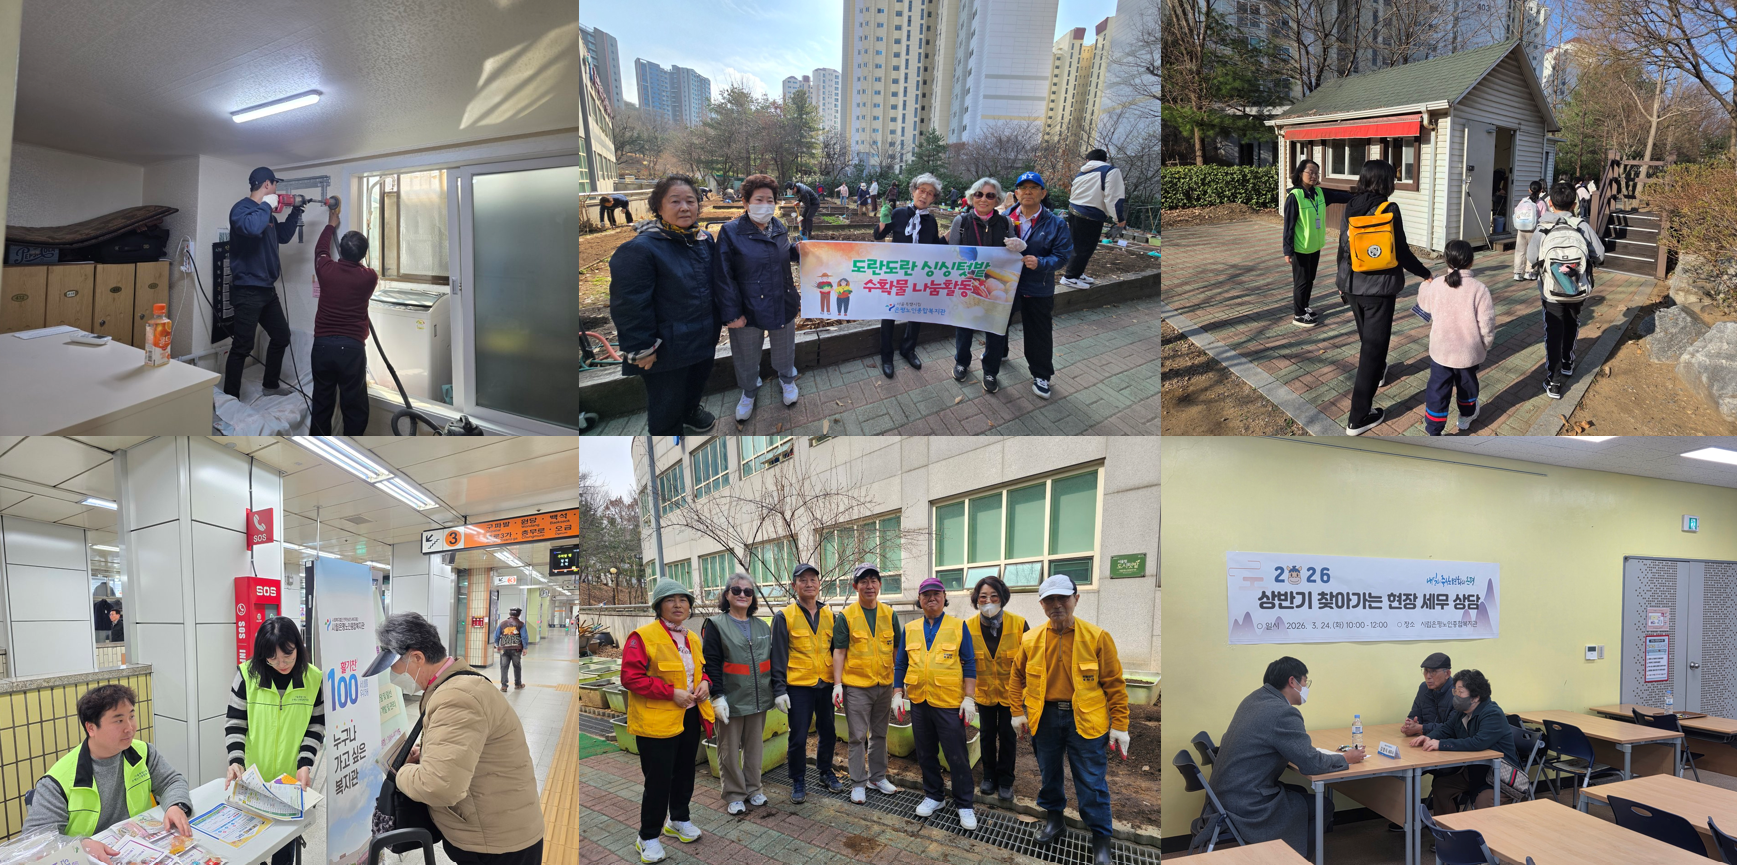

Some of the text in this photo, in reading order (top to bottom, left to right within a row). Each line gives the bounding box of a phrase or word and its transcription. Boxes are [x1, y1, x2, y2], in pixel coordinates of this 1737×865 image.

[851, 258, 992, 278] 도란도란 싱싱텃밭
[863, 278, 973, 298] 수확물 나눔활동
[894, 307, 946, 316] 은평노인종합복지관
[486, 512, 568, 530] 구파발 원당 백석
[521, 527, 545, 536] 충무로
[555, 524, 572, 532] 오금
[253, 533, 267, 543] SOS
[448, 532, 458, 545] 3
[256, 585, 277, 596] SOS
[1257, 590, 1481, 610] 상반기 찾아가는 현장 세무 상담
[238, 620, 246, 639] SOS
[1265, 622, 1280, 631] 일시
[1286, 622, 1308, 630] 2026.
[1311, 622, 1319, 630] 3.
[1403, 620, 1416, 629] 장소
[1420, 620, 1478, 629] 시립은평노인종합복지관
[340, 659, 358, 674] 활기찬
[327, 668, 359, 711] 100
[333, 725, 357, 750] 누구나
[334, 742, 367, 774] 가고 싶은
[335, 768, 359, 796] 복지관
